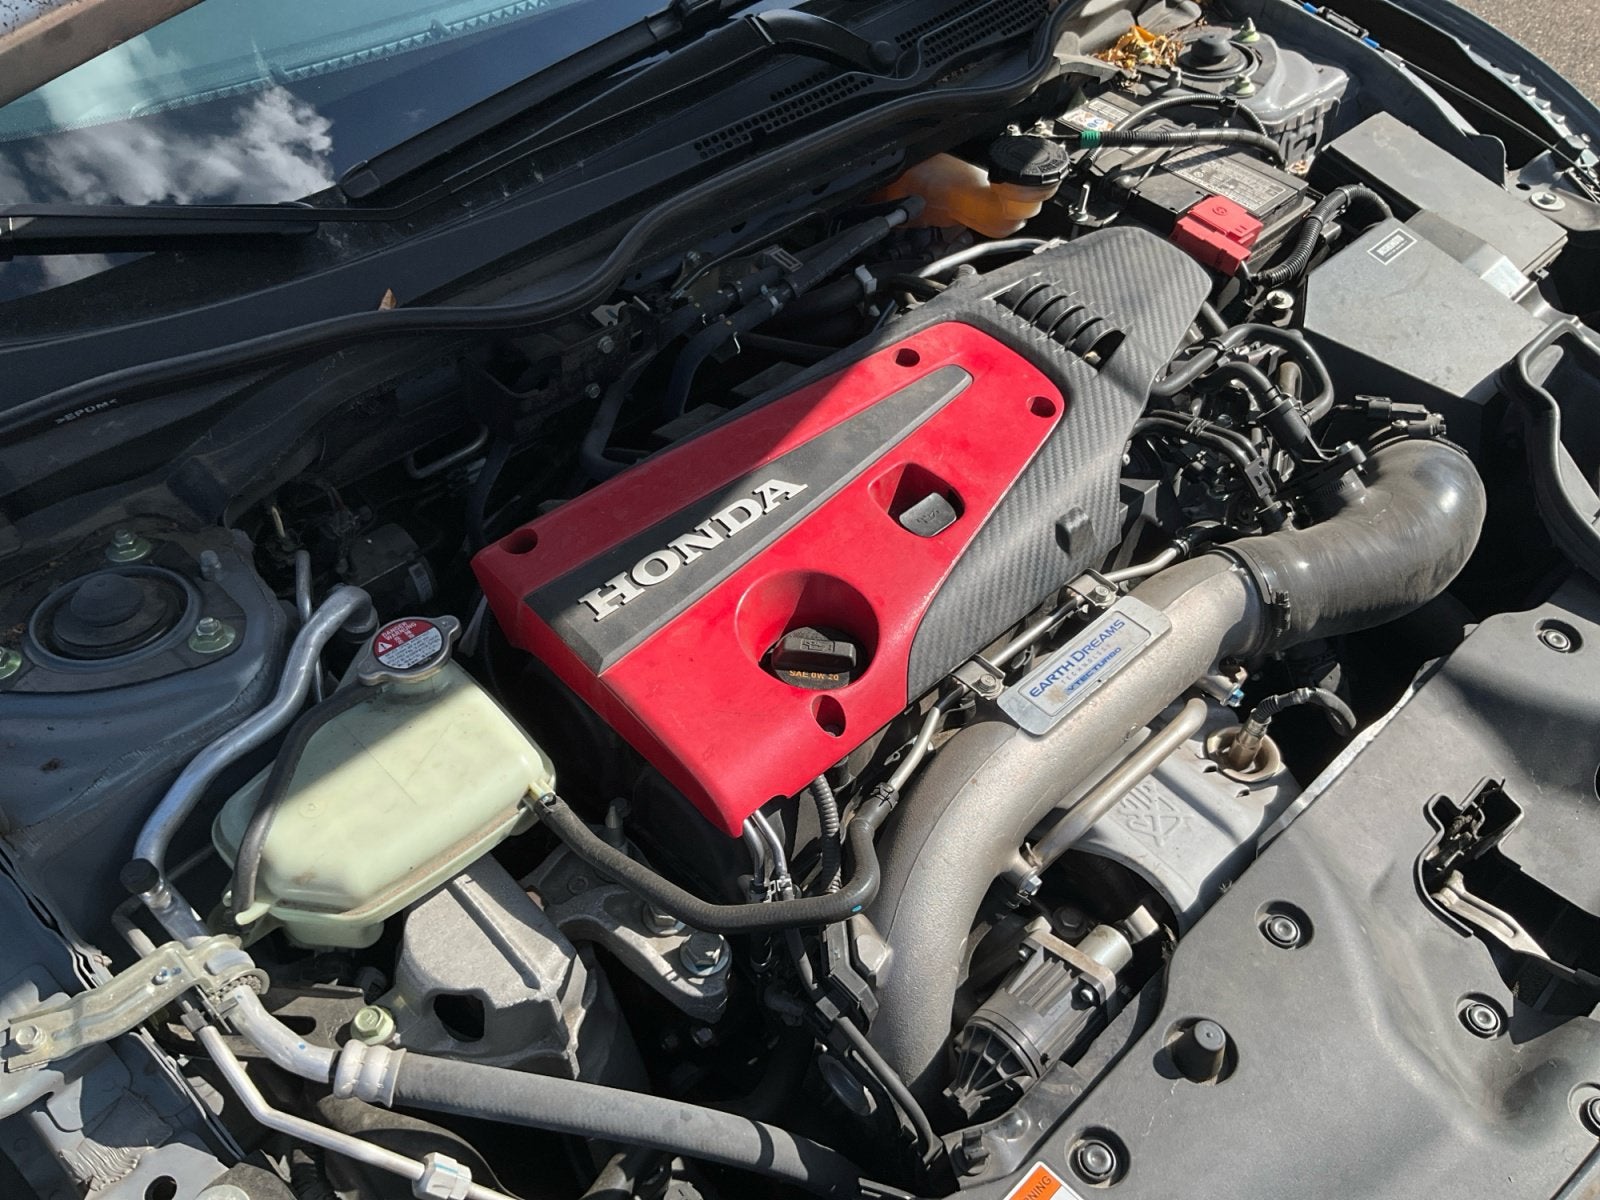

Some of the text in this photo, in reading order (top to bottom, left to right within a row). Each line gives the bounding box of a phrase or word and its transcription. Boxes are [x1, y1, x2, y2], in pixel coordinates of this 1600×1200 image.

[577, 478, 809, 621] HONDA
[789, 670, 809, 678] SAE
[1029, 661, 1074, 698] EARTH
[1021, 1175, 1052, 1200] NING
